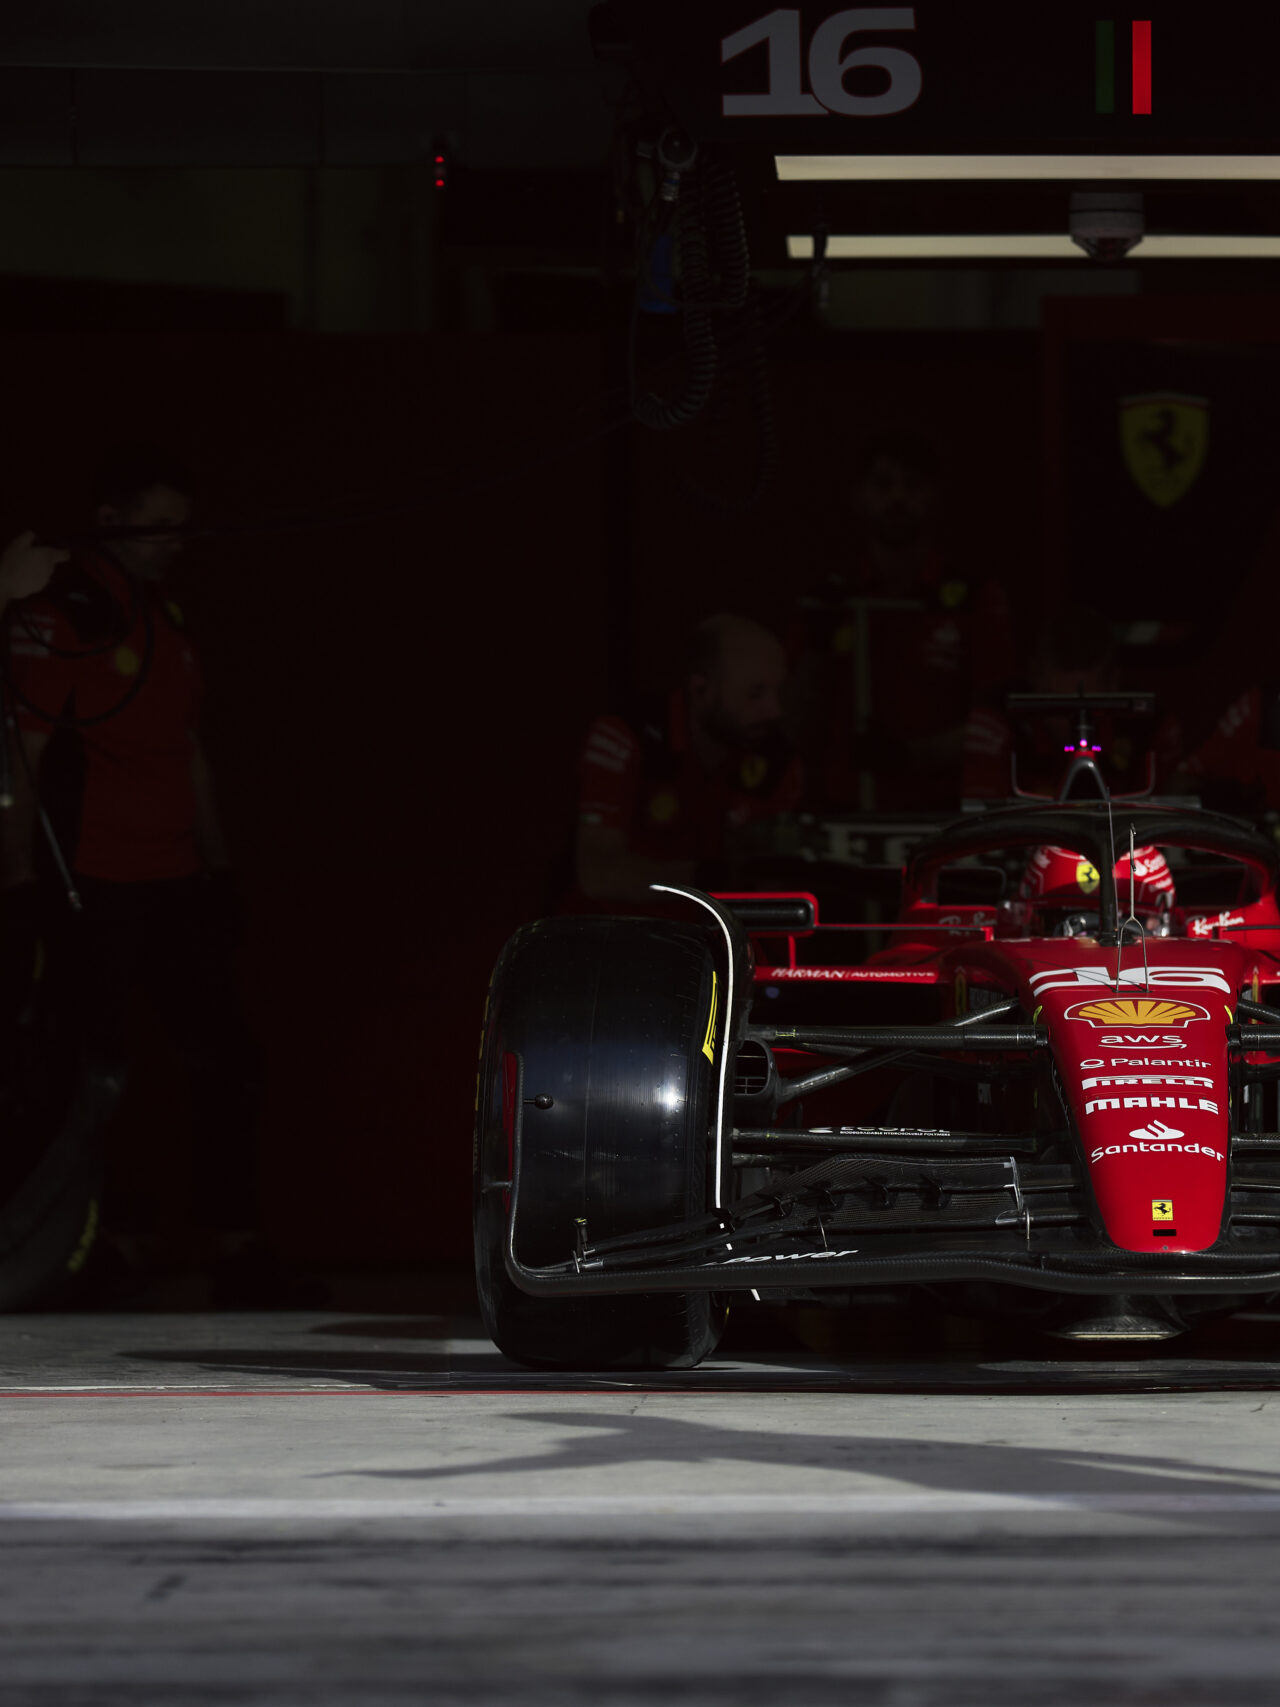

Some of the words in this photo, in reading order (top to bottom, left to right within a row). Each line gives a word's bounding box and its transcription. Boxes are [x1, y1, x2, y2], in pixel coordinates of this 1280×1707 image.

[720, 7, 922, 116] 16
[771, 968, 844, 979] HARMAN
[850, 970, 935, 978] AUTOMOTIVE
[1100, 1034, 1184, 1045] aws
[1111, 1058, 1211, 1068] Palantir
[1082, 1075, 1215, 1090] PIRELLI
[1085, 1097, 1219, 1115] MAHLE
[1091, 1142, 1224, 1163] Santander
